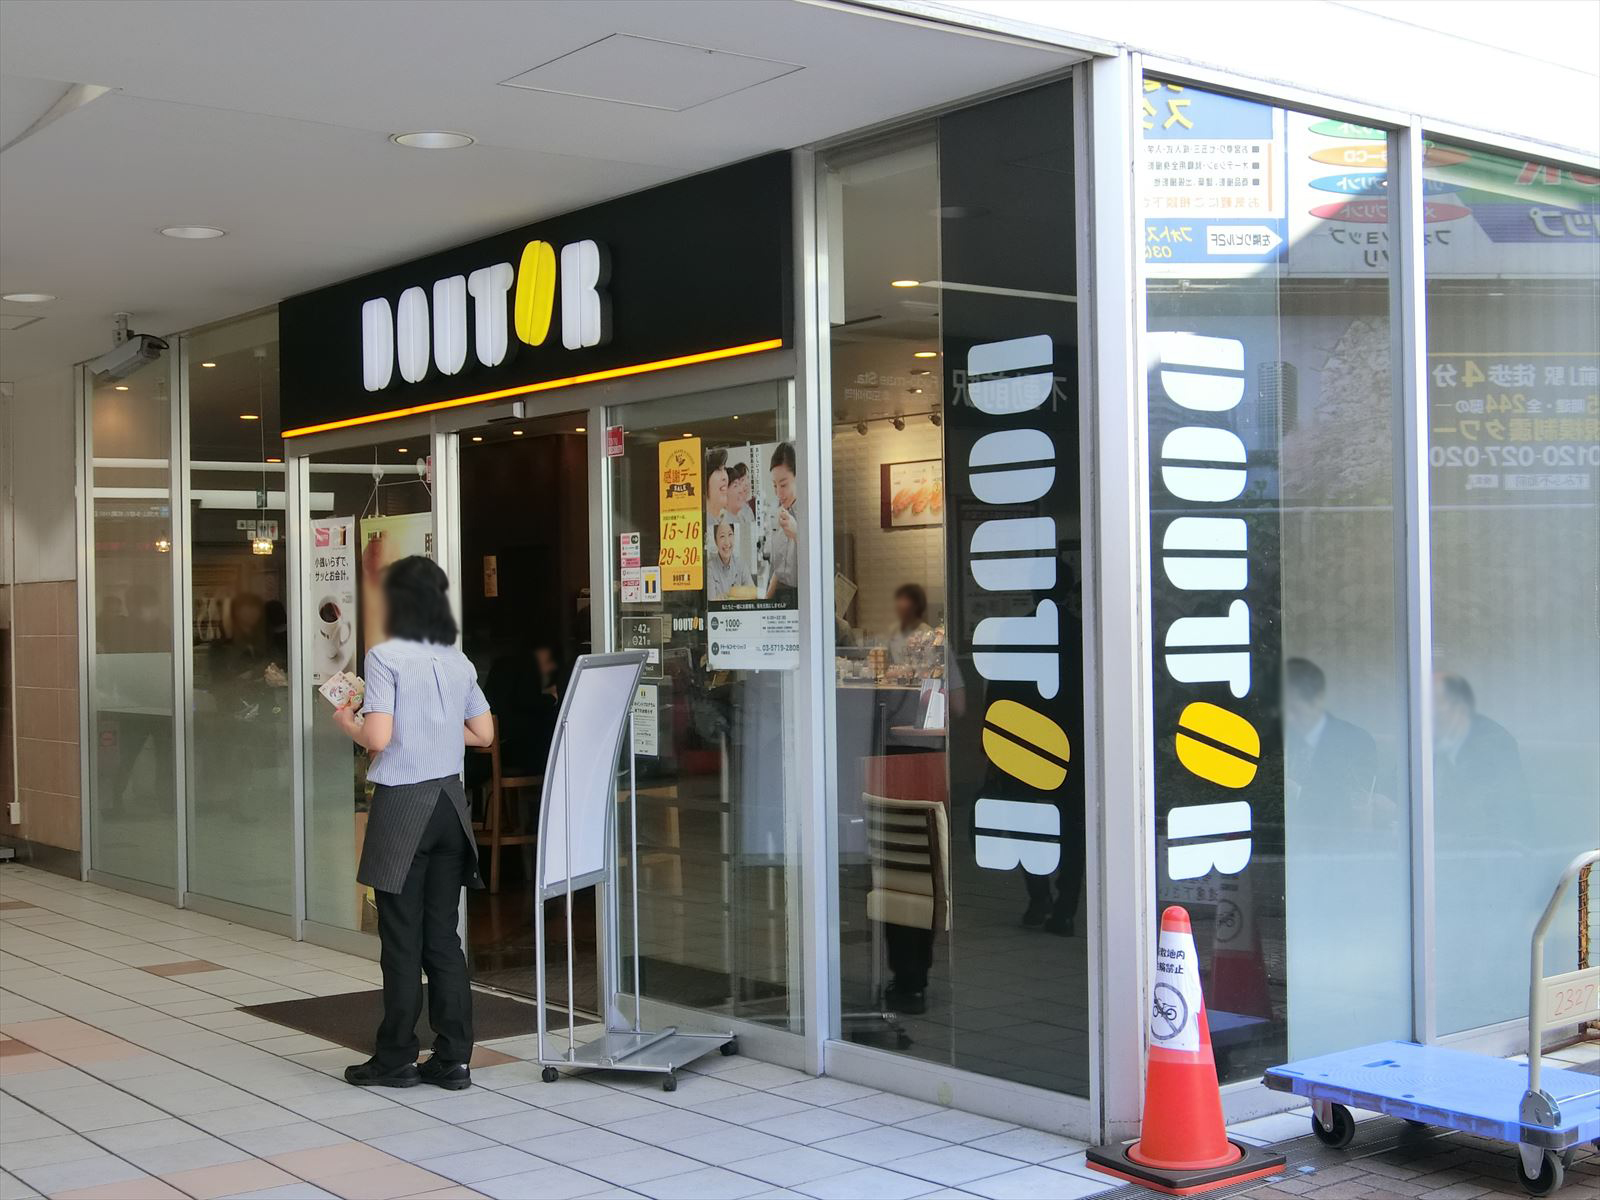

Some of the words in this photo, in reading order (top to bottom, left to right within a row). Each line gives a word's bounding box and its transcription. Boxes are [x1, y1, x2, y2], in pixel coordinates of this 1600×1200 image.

[361, 240, 608, 392] DOUTOR
[663, 467, 698, 484] 感謝デー
[315, 556, 349, 569] 小銭いらずで、
[315, 570, 350, 582] サッとお会計。
[966, 334, 1070, 876] DOUTOR
[1160, 335, 1260, 880] DOUTOR
[672, 616, 704, 632] DOUTOR
[1554, 983, 1595, 1015] 2327
